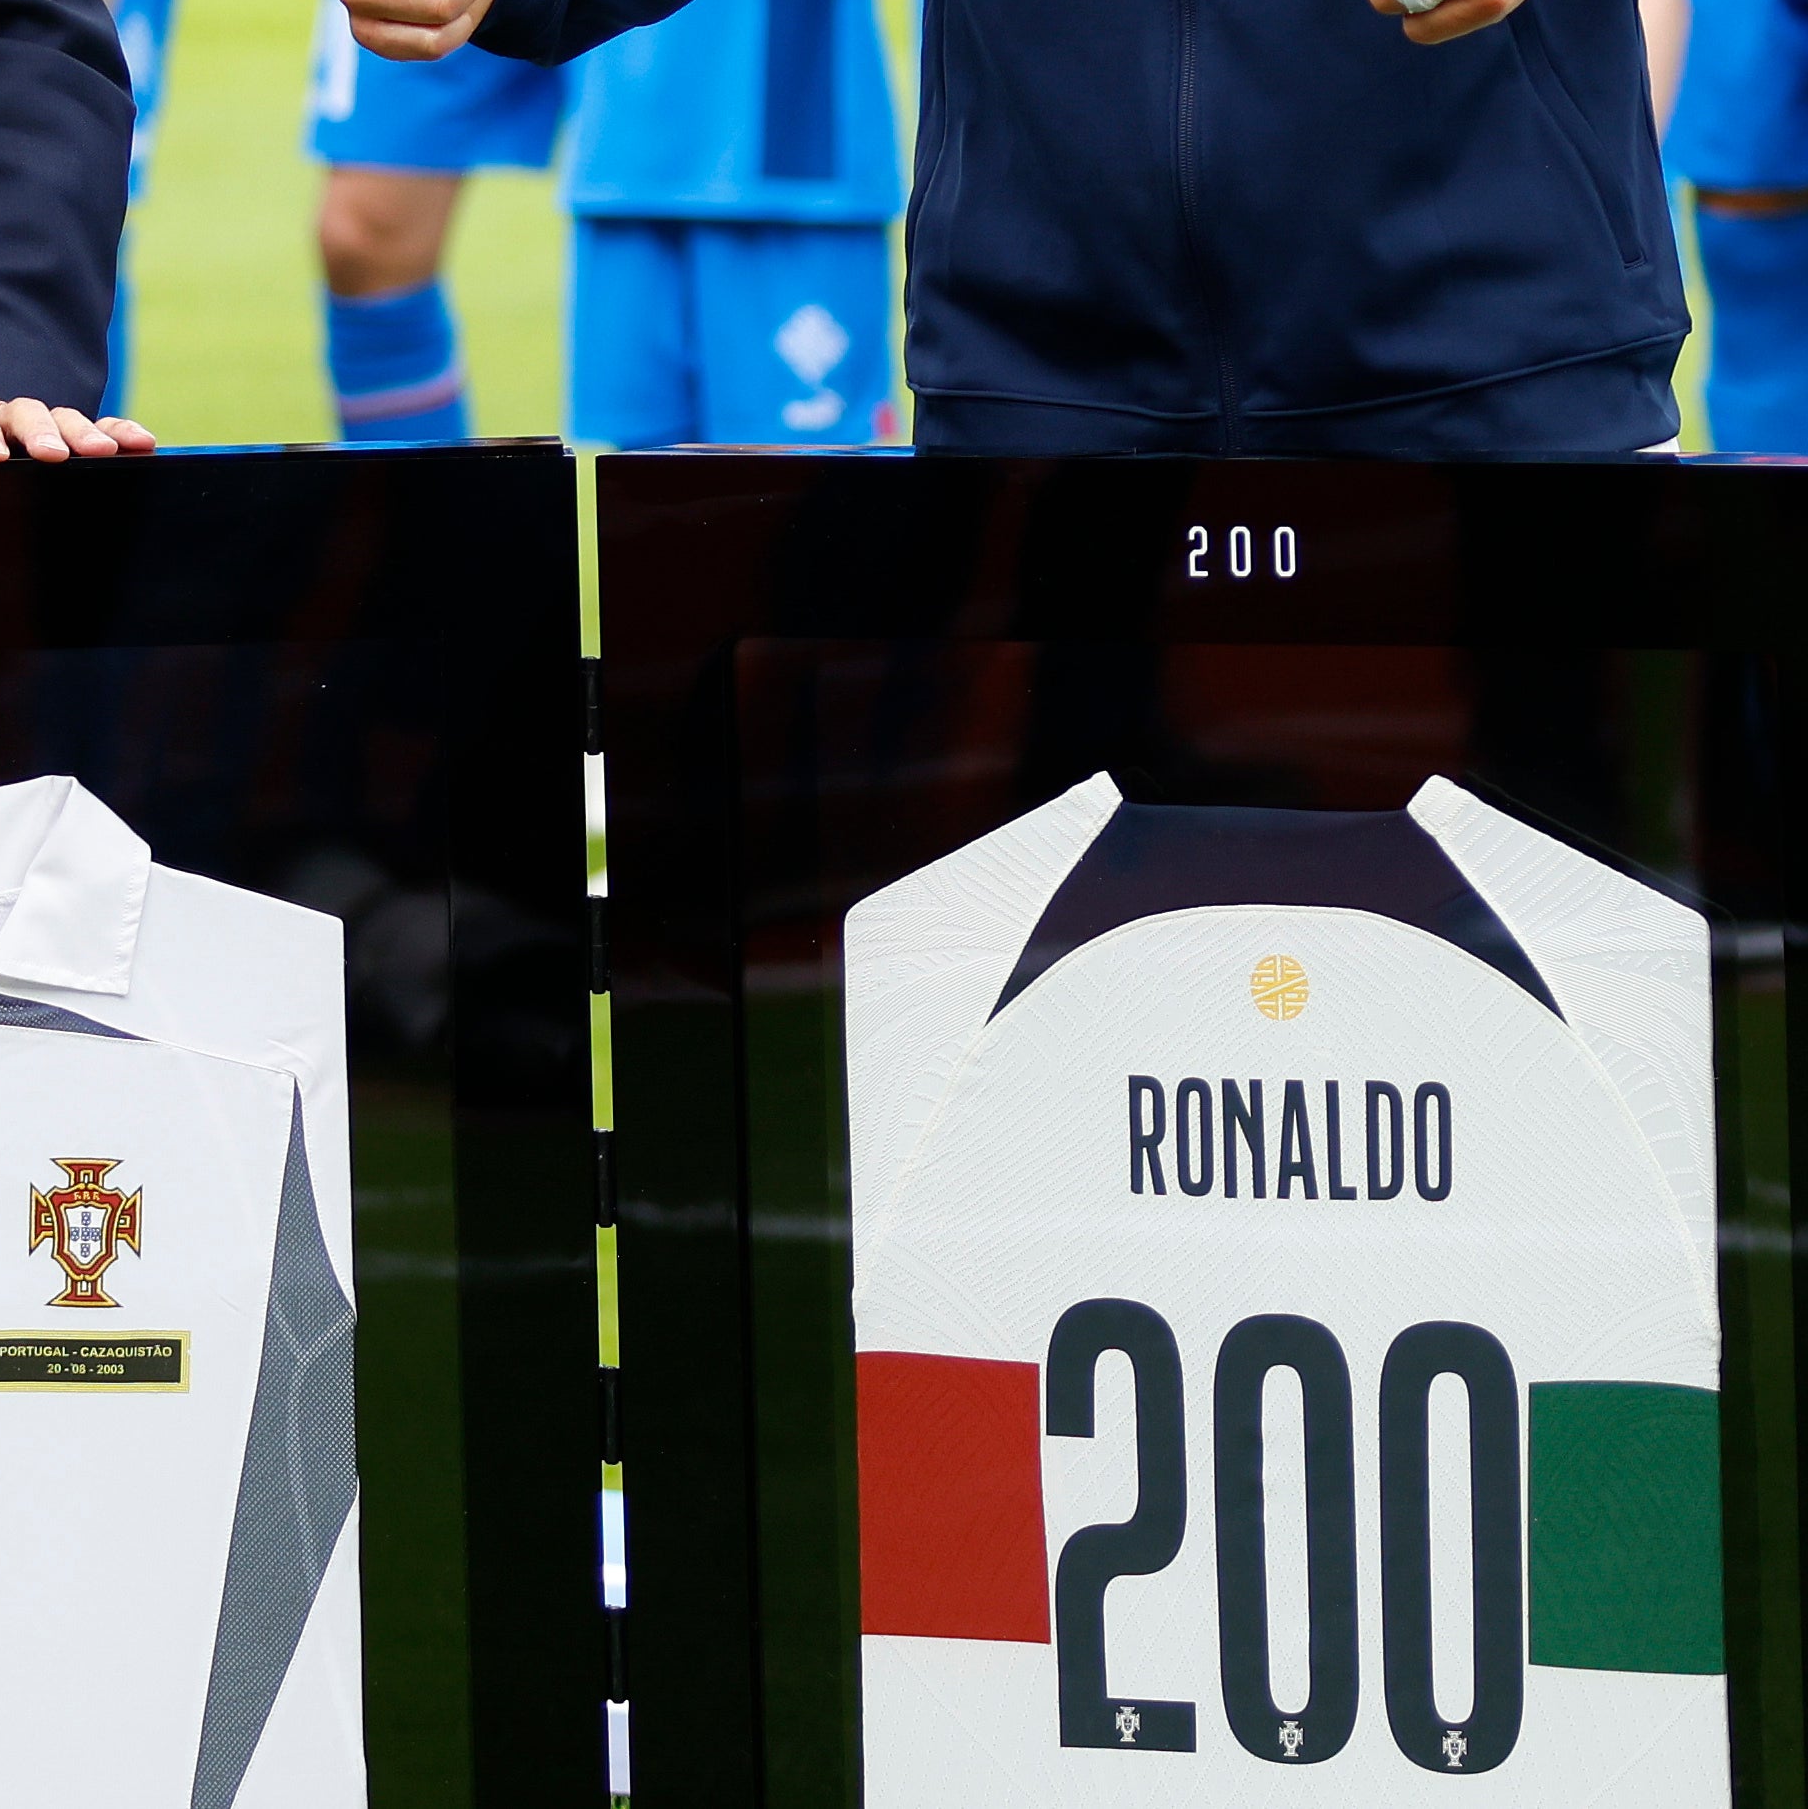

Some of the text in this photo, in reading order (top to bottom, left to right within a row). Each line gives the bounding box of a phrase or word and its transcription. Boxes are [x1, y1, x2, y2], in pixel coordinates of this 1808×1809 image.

[1188, 525, 1296, 578] 200
[1129, 1075, 1452, 1202] RONALDO
[0, 1346, 69, 1358] PORTUGAL
[80, 1344, 173, 1358] CAZAQUISTÃO
[47, 1364, 61, 1374] 20
[72, 1364, 87, 1375] 08
[97, 1364, 124, 1375] 2003
[1045, 1297, 1524, 1775] 200
